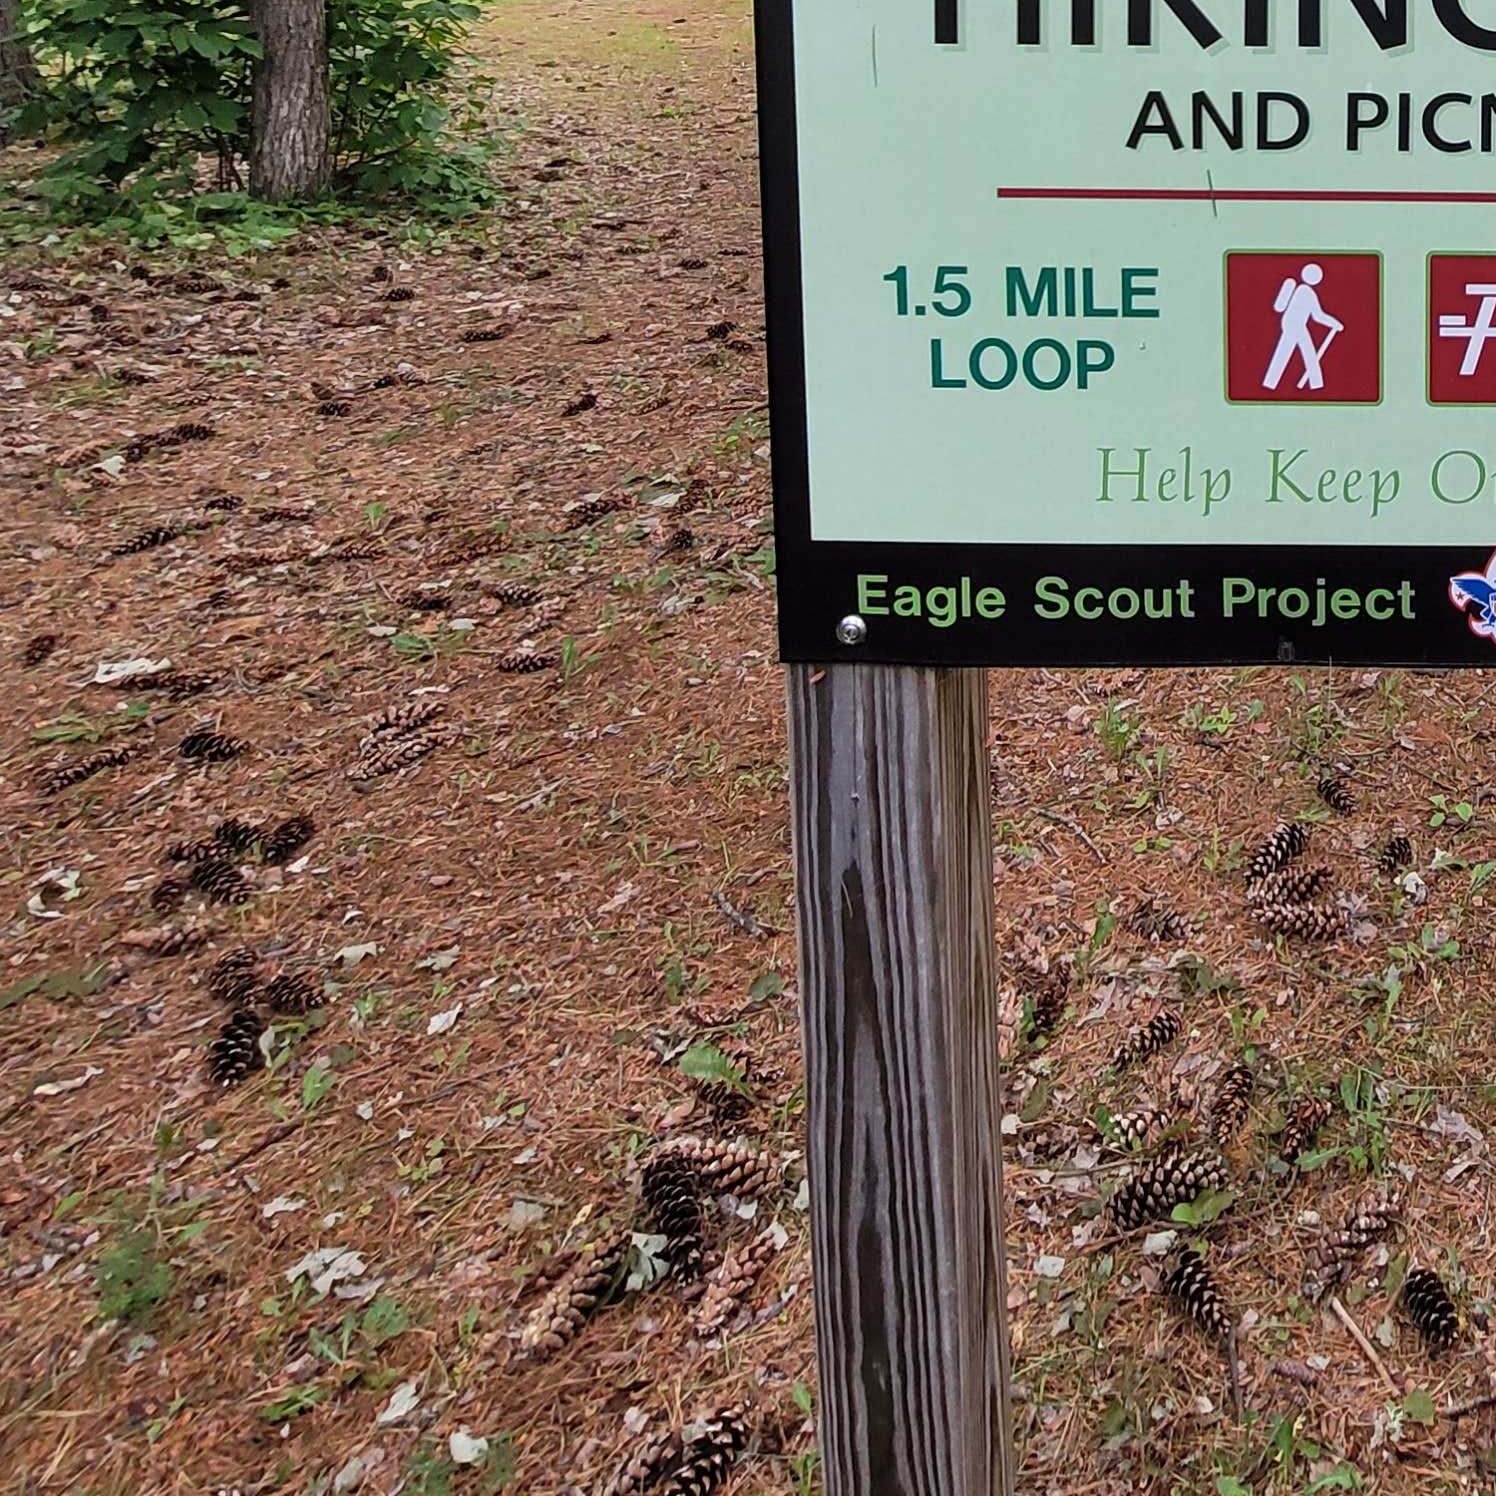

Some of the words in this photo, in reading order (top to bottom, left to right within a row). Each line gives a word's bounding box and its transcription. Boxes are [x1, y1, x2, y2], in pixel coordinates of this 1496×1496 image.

[1125, 90, 1310, 151] AND
[882, 264, 972, 318] 1.5
[1005, 266, 1161, 319] MILE
[930, 337, 1116, 391] LOOP
[1093, 446, 1233, 518] Help
[1262, 447, 1402, 519] Keep
[856, 574, 1007, 628] Eagle
[1034, 576, 1195, 620] Scout
[1222, 577, 1416, 627] Project
